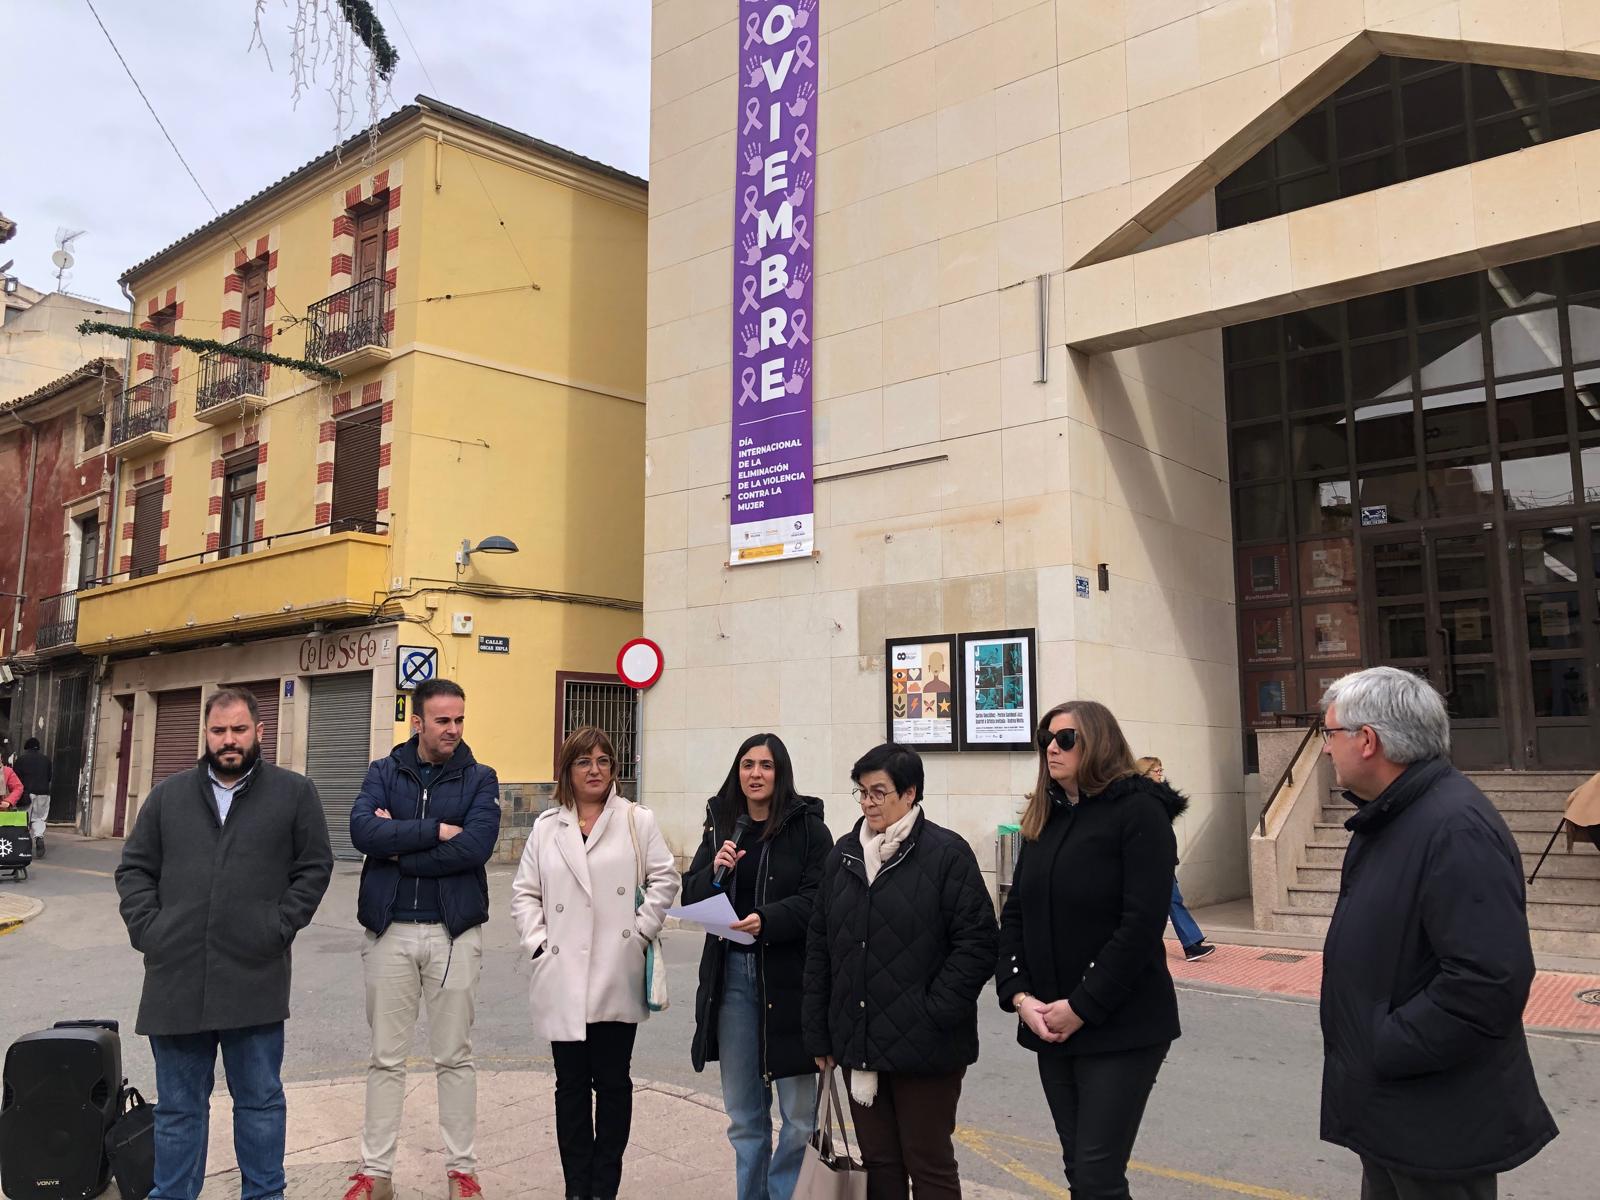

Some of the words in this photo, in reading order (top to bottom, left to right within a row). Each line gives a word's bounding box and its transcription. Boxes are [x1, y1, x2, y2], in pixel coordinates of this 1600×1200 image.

[738, 437, 753, 447] DÍA
[738, 439, 802, 458] INTERNACIONAL
[738, 460, 750, 468] DE
[738, 463, 789, 479] ELIMINACIÓN
[738, 481, 749, 490] DE
[751, 480, 762, 488] LA
[763, 472, 806, 486] VIOLENCIA
[738, 489, 770, 500] CONTRA
[771, 487, 782, 495] LA
[738, 500, 765, 511] MUJER
